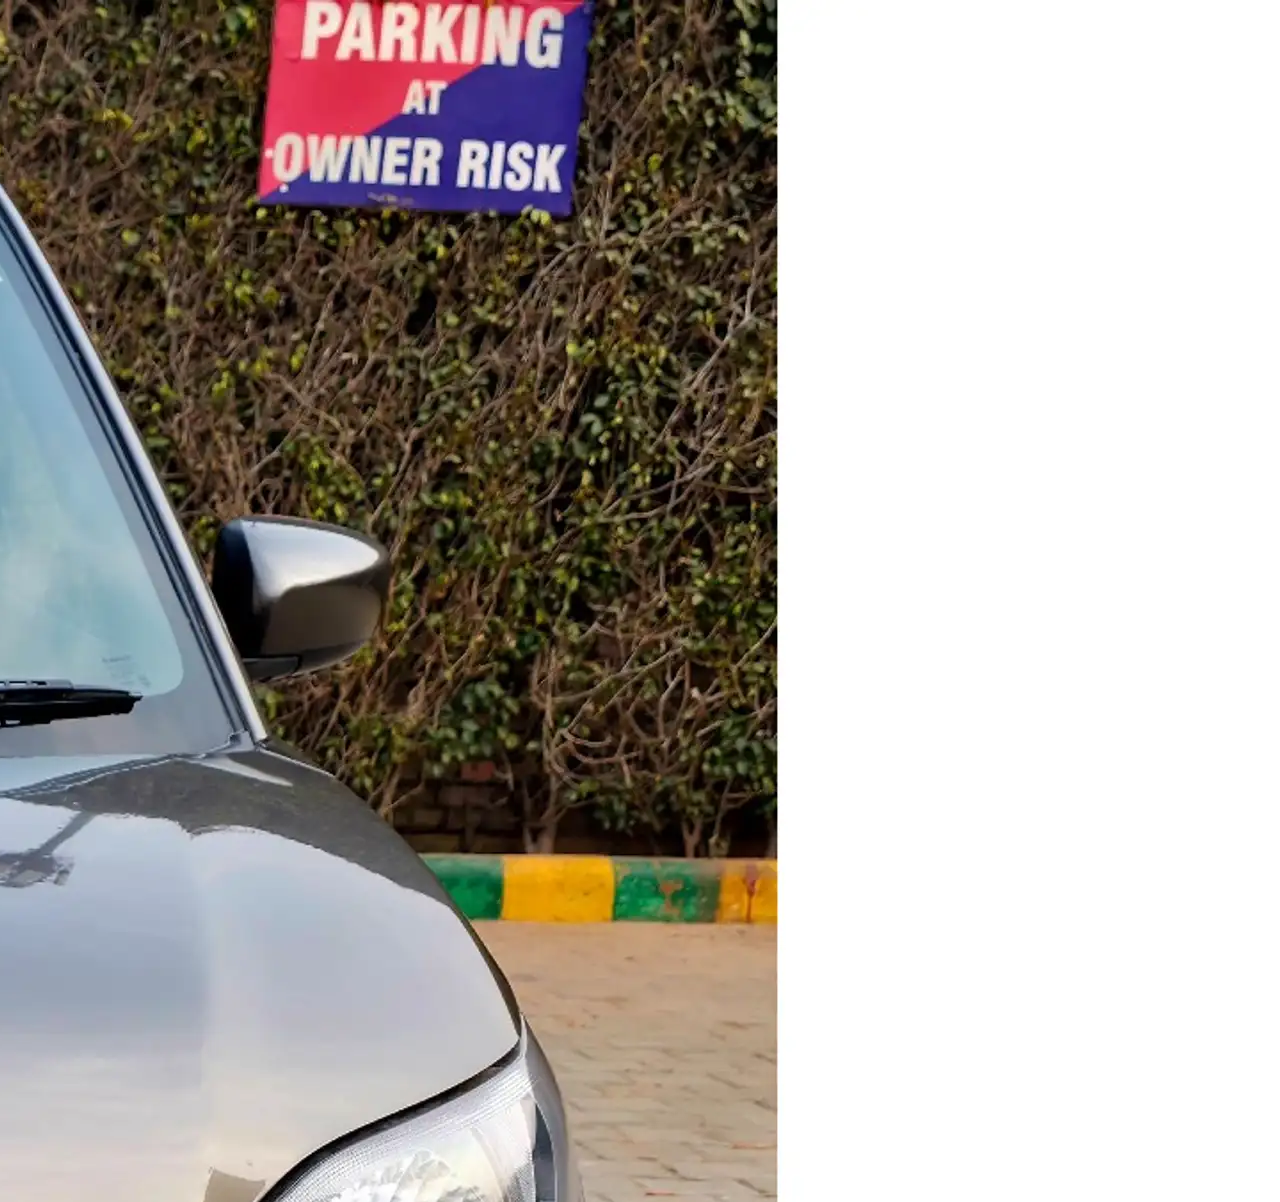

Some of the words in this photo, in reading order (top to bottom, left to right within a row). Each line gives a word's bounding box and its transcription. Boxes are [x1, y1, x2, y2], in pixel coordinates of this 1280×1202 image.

[300, 0, 566, 69] PARKING
[401, 79, 447, 116] AT
[272, 131, 444, 185] OWNER
[455, 139, 567, 193] RISK
